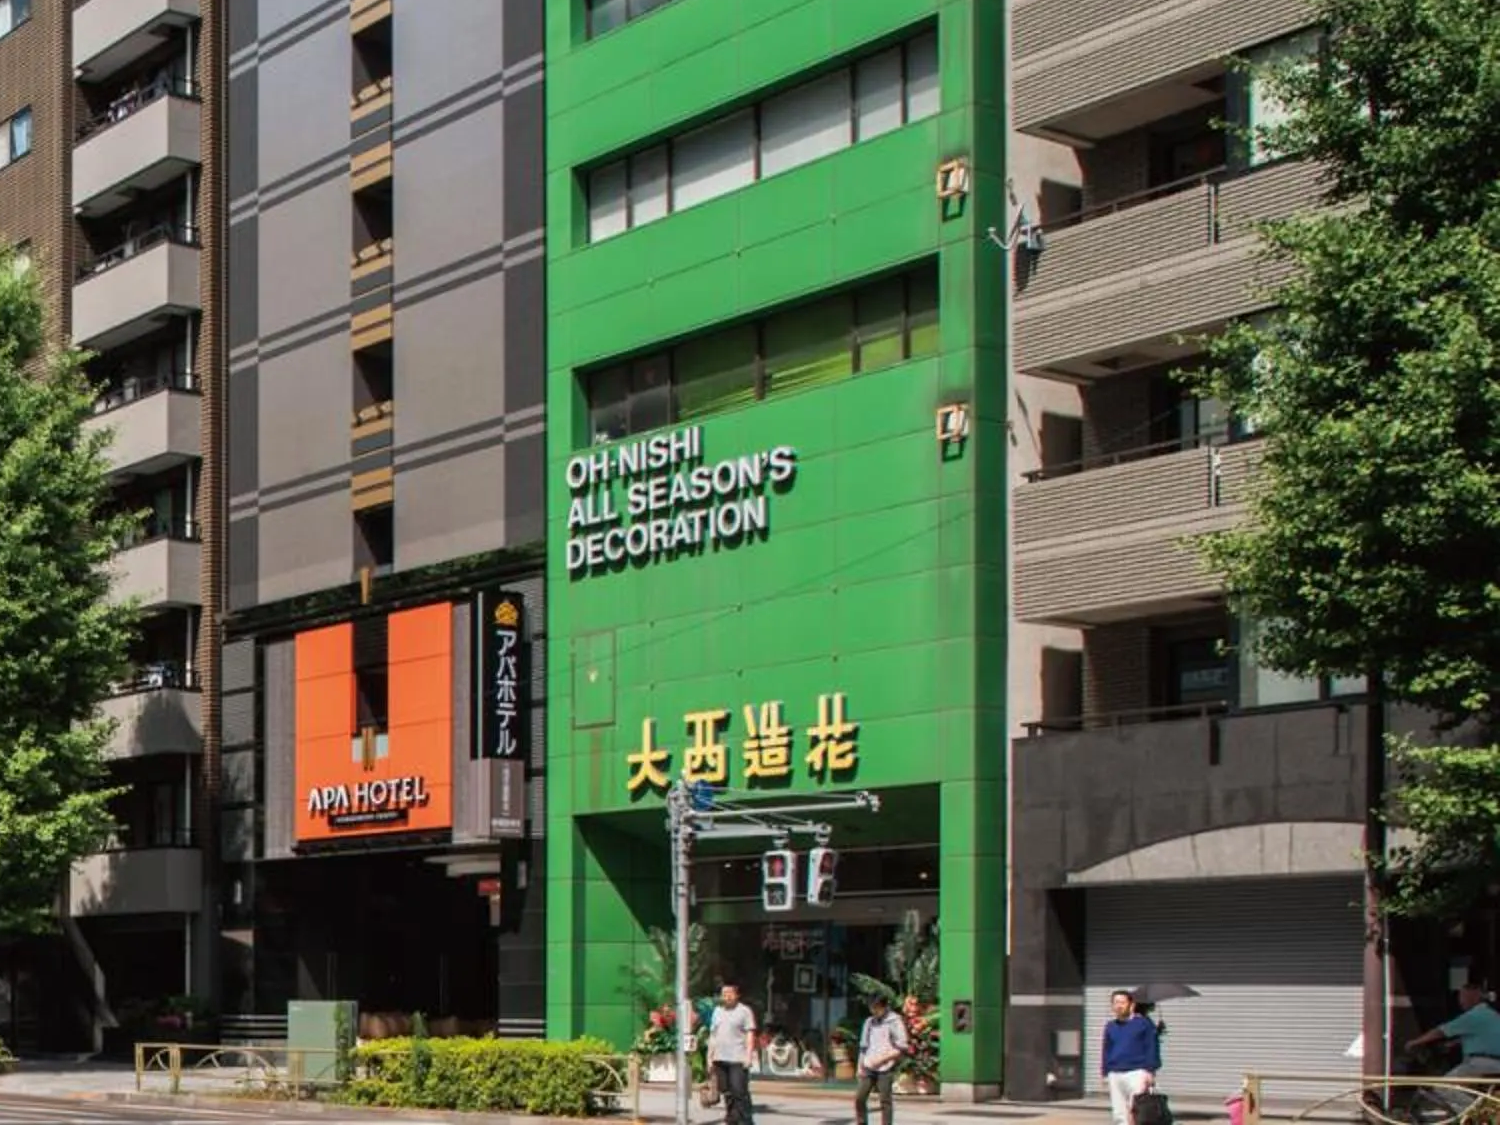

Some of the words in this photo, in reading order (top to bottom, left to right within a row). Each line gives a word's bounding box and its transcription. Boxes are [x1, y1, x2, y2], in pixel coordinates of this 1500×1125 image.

[567, 490, 618, 529] ALL
[628, 446, 794, 515] SEASON'S
[566, 495, 766, 570] DECORATION
[495, 630, 518, 756] アパホテル
[627, 692, 858, 791] 大西造花
[307, 784, 350, 812] APA
[355, 776, 426, 805] HOTEL
